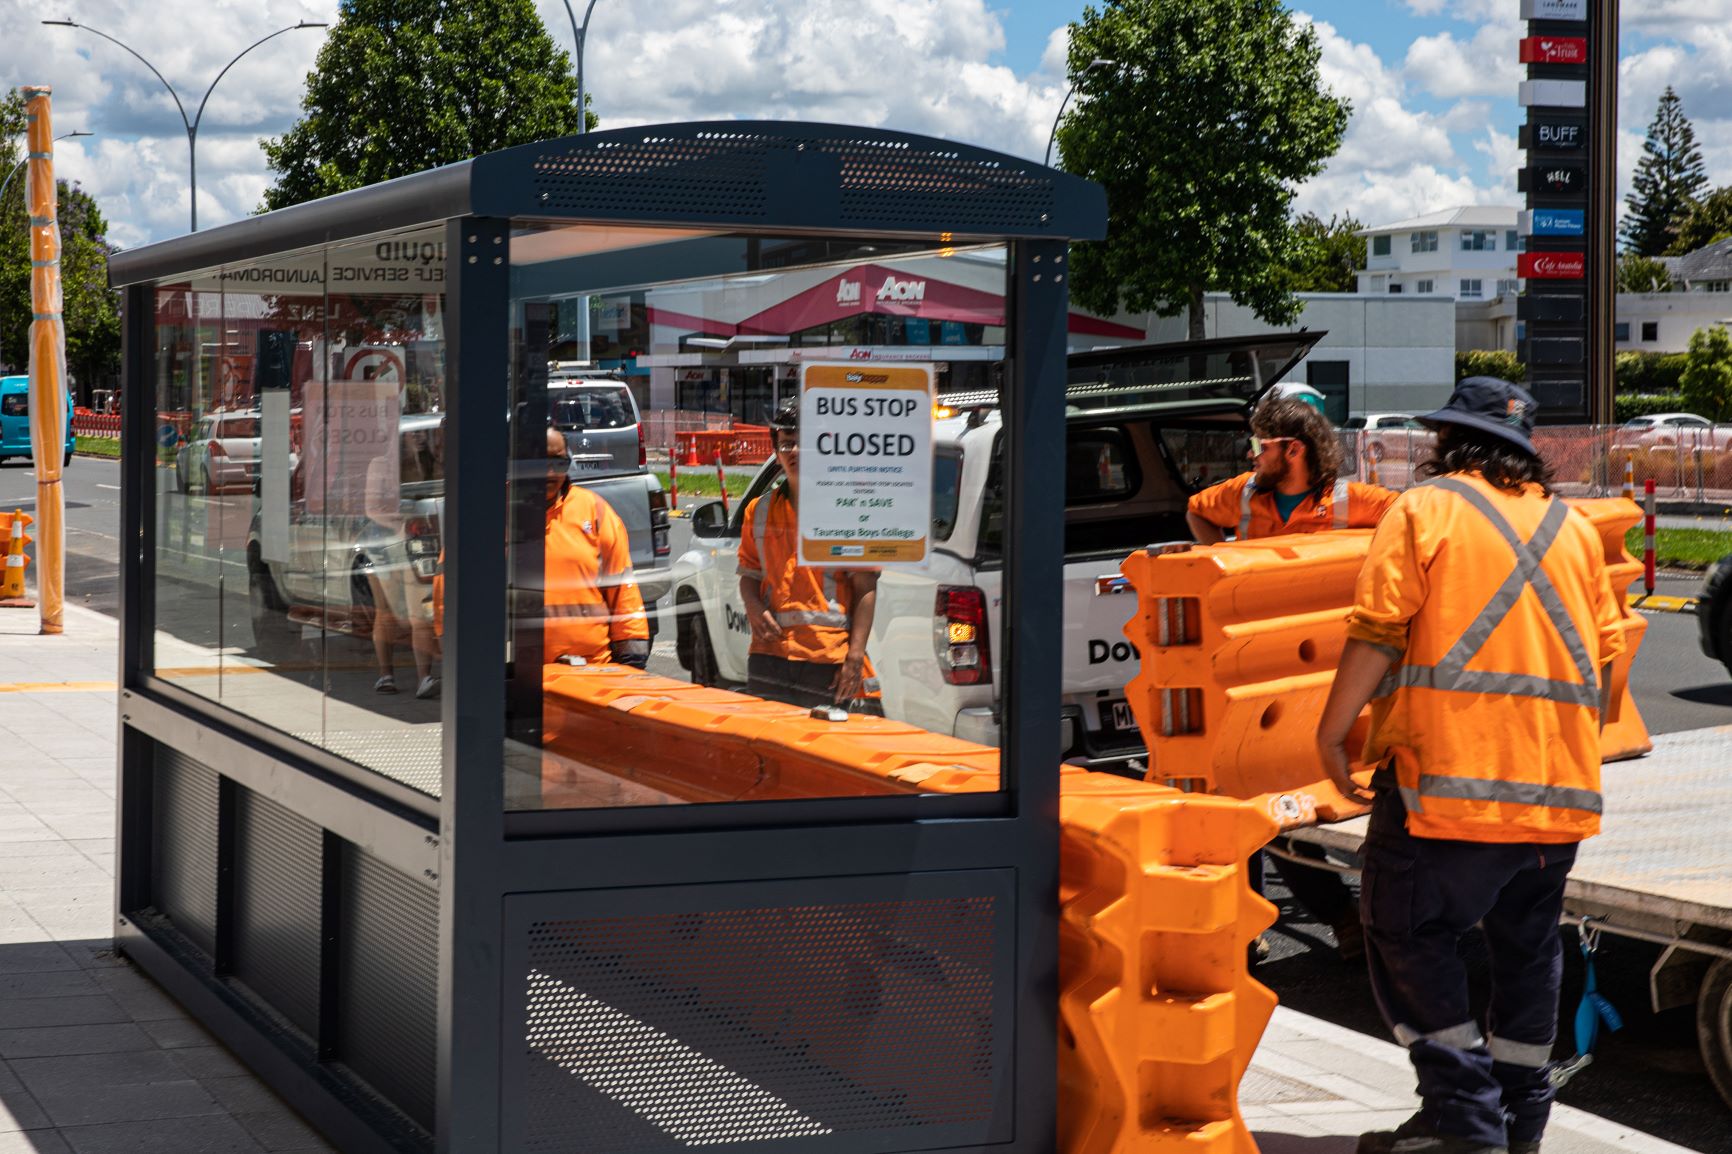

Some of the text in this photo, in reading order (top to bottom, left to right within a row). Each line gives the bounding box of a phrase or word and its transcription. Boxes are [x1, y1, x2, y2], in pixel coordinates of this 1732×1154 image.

[1539, 125, 1579, 141] BUFF
[1547, 170, 1571, 184] HELL
[816, 397, 917, 417] BUS STOP
[816, 432, 916, 457] CLOSED
[813, 528, 856, 539] Tauranga
[881, 528, 915, 539] College
